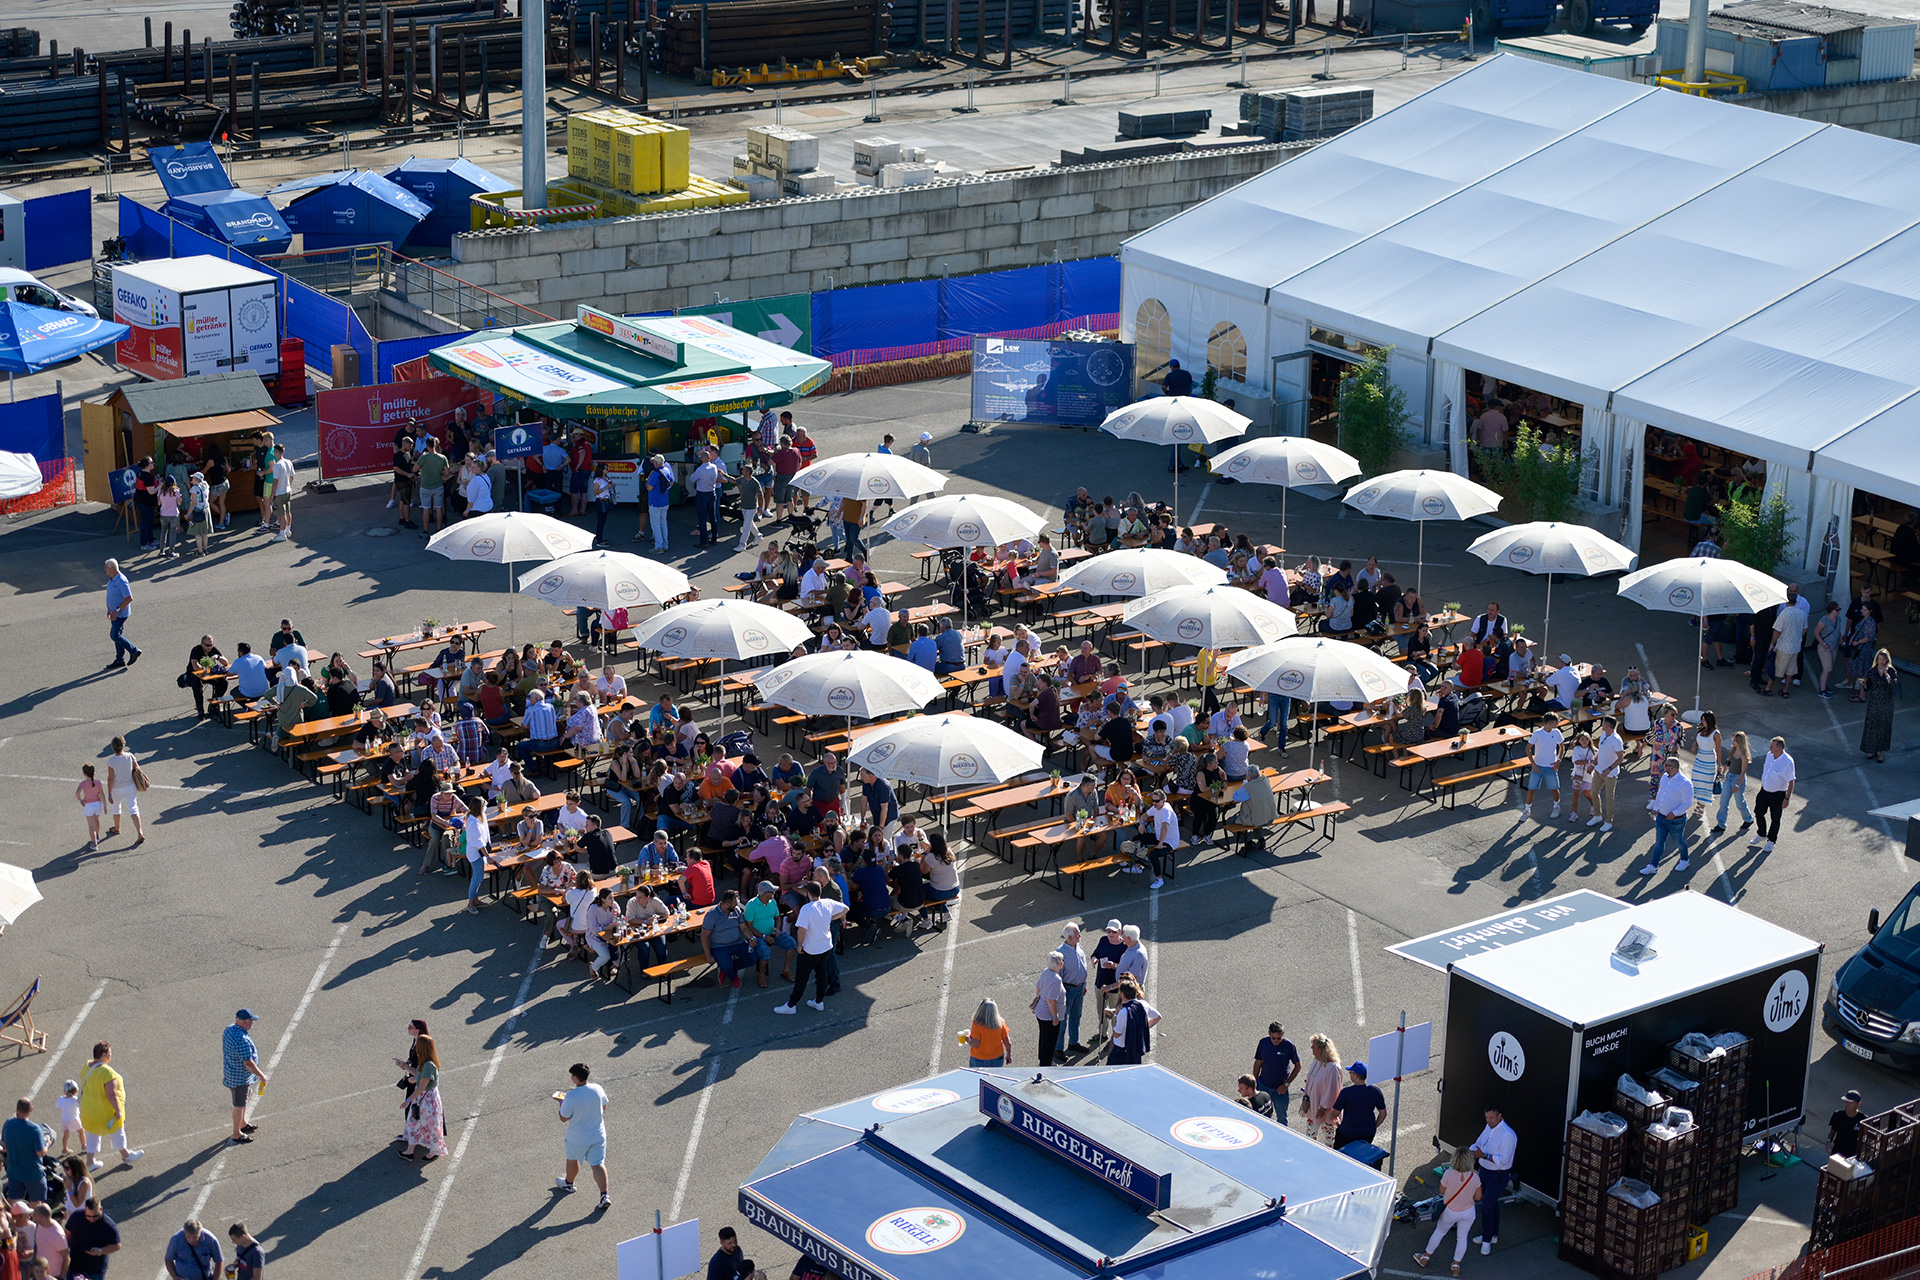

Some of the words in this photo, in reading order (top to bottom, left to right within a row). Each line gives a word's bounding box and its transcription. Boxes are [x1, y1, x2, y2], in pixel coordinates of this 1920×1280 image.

[167, 162, 213, 174] BRANDMAYR
[225, 216, 272, 227] BRANDMAYR
[117, 288, 148, 310] GEFAKO
[37, 316, 79, 333] GEFAKO
[196, 316, 218, 325] müller
[196, 322, 227, 333] getränke
[156, 344, 172, 356] müller
[249, 342, 273, 351] GEFAKO
[156, 353, 178, 367] getränke
[537, 364, 587, 382] GEFAKO
[383, 398, 418, 410] müller
[586, 405, 638, 417] Königsbacher
[709, 399, 754, 414] Königsbacher
[383, 407, 431, 423] getränke
[507, 446, 532, 454] GETRÄNKE
[1535, 904, 1576, 921] viel
[1439, 917, 1541, 950] dahinter!
[1770, 986, 1801, 1023] Jim's
[1585, 1035, 1606, 1049] BUCH
[1606, 1027, 1628, 1042] MICH!
[1592, 1041, 1620, 1057] JIMS.DE
[1493, 1041, 1519, 1076] Jim's
[1021, 1110, 1104, 1170] RIEGELE
[1104, 1159, 1133, 1188] Treff
[744, 1200, 838, 1269] BRAUHAUS
[889, 1217, 940, 1246] RIEGELE
